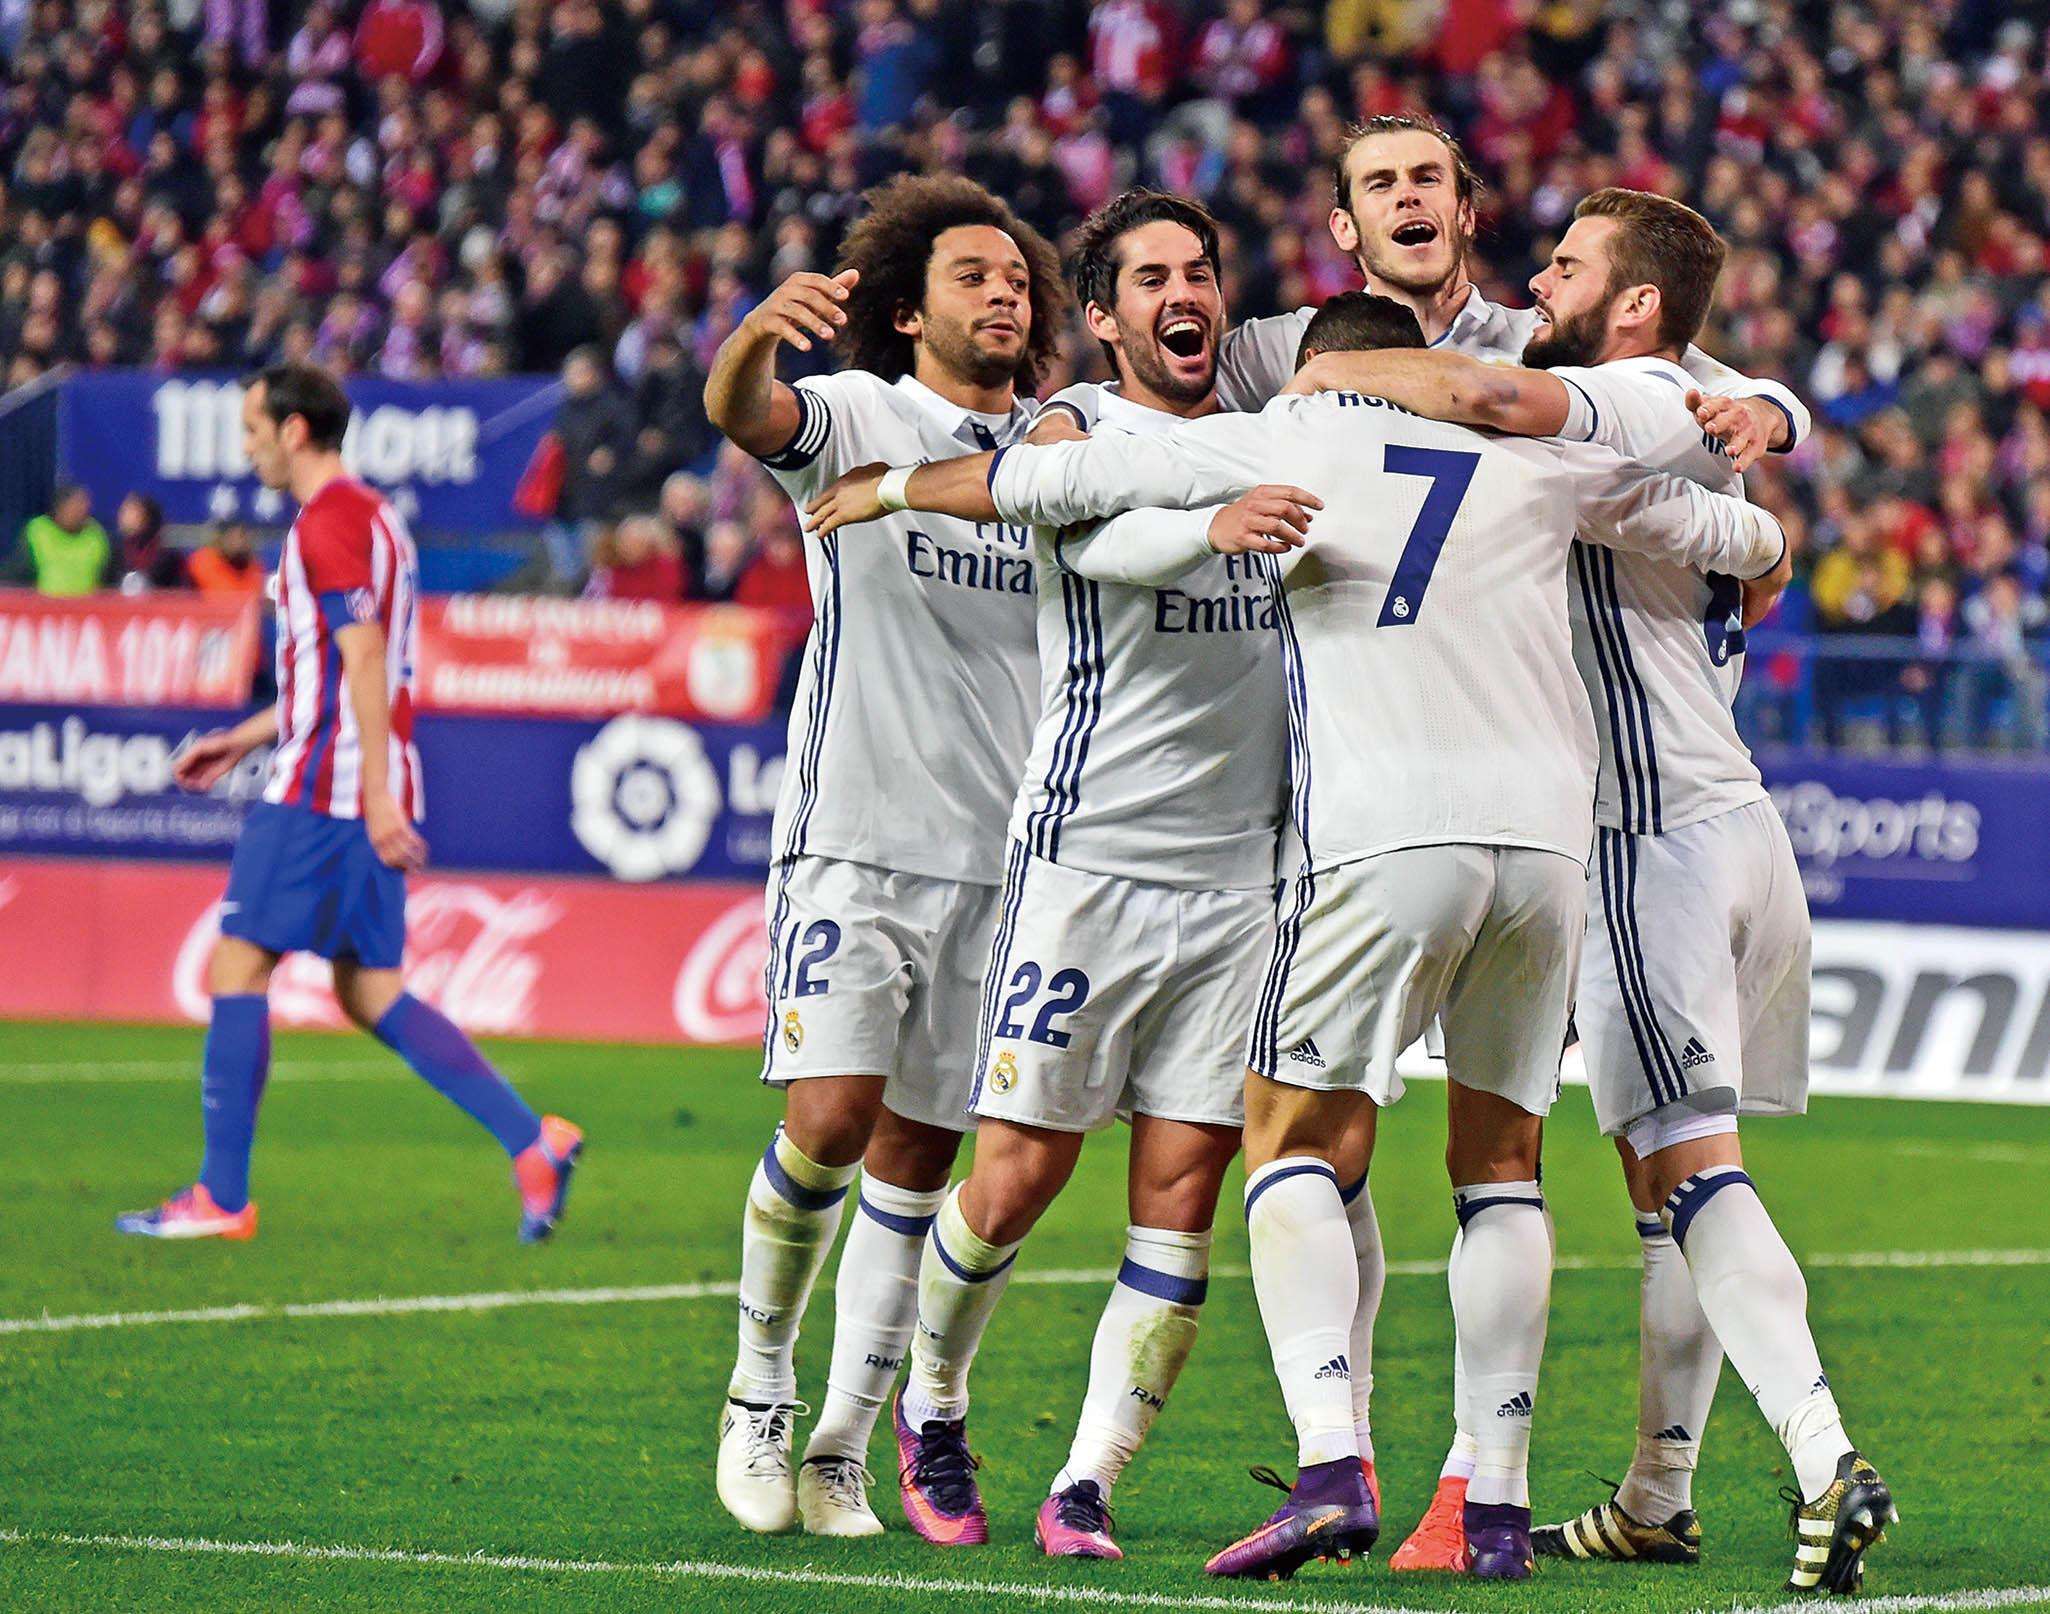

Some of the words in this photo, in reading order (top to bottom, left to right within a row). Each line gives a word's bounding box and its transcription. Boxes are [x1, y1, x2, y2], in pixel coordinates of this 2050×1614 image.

[907, 530, 1034, 595] Emira
[1376, 443, 1482, 628] 7
[1155, 584, 1279, 633] Emira
[779, 918, 841, 999] 12
[995, 961, 1089, 1048] 22
[1290, 1052, 1326, 1068] adidas
